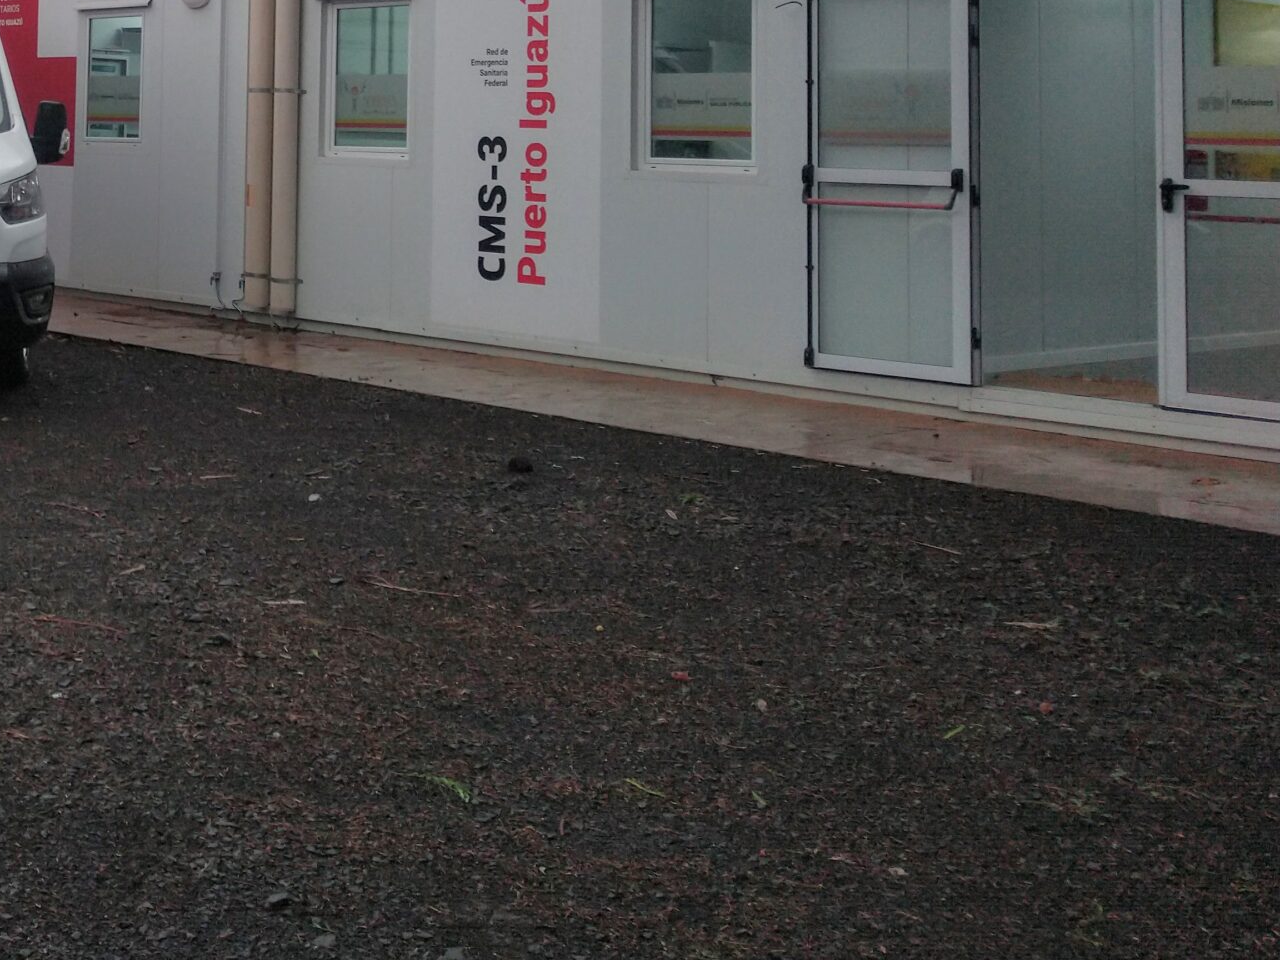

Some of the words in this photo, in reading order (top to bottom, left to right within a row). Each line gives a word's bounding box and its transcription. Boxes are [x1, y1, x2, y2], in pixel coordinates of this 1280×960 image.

[486, 48, 499, 56] Red
[500, 48, 509, 56] de
[470, 58, 509, 68] Emergencia
[479, 69, 509, 77] Sanitaria
[484, 79, 509, 87] Federal
[477, 135, 508, 281] CMS-3
[517, 141, 548, 286] Puerto
